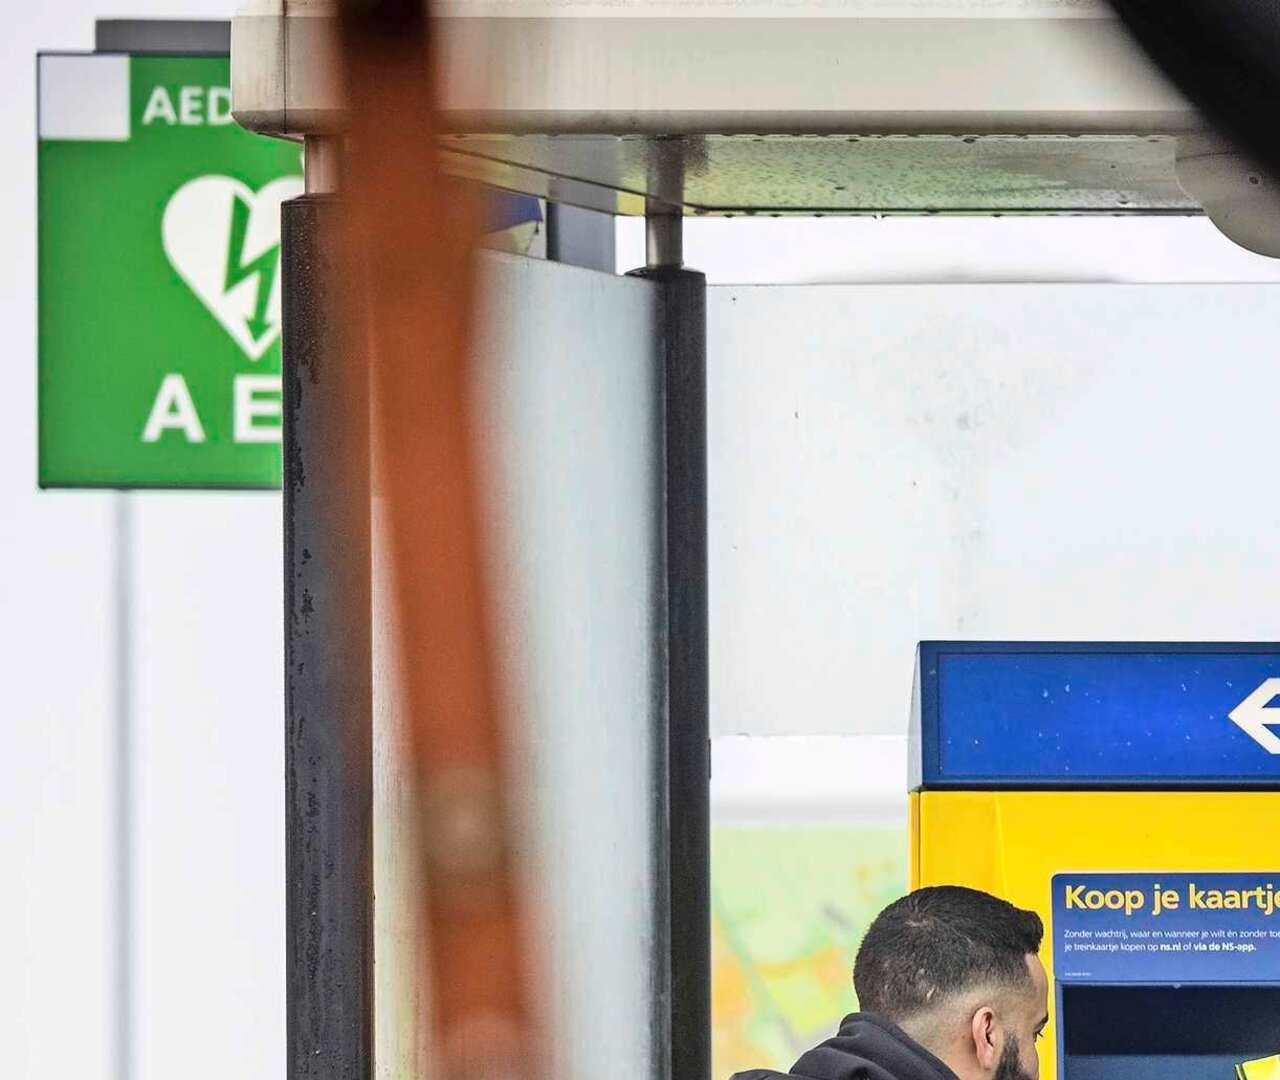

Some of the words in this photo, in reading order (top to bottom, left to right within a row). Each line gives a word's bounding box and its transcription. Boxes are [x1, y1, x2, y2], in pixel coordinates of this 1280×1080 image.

[142, 86, 232, 126] AED
[1065, 885, 1145, 916] Koop
[1152, 883, 1180, 916] je
[1064, 929, 1092, 939] Zonder
[1095, 929, 1129, 940] wachtrij,
[1130, 931, 1150, 939] waar
[1152, 931, 1163, 939] en
[1164, 931, 1200, 939] wanneer
[1201, 929, 1209, 940] je
[1211, 929, 1225, 939] wilt
[1240, 929, 1268, 939] zonder
[1064, 942, 1072, 953] je
[1074, 942, 1119, 953] treinkaartje
[1120, 942, 1146, 953] kopen
[1147, 943, 1159, 953] op
[1160, 942, 1182, 951] ns.nl
[1183, 942, 1192, 951] of
[1193, 942, 1207, 951] via
[1208, 942, 1221, 951] de
[1222, 942, 1257, 953] NS-app.
